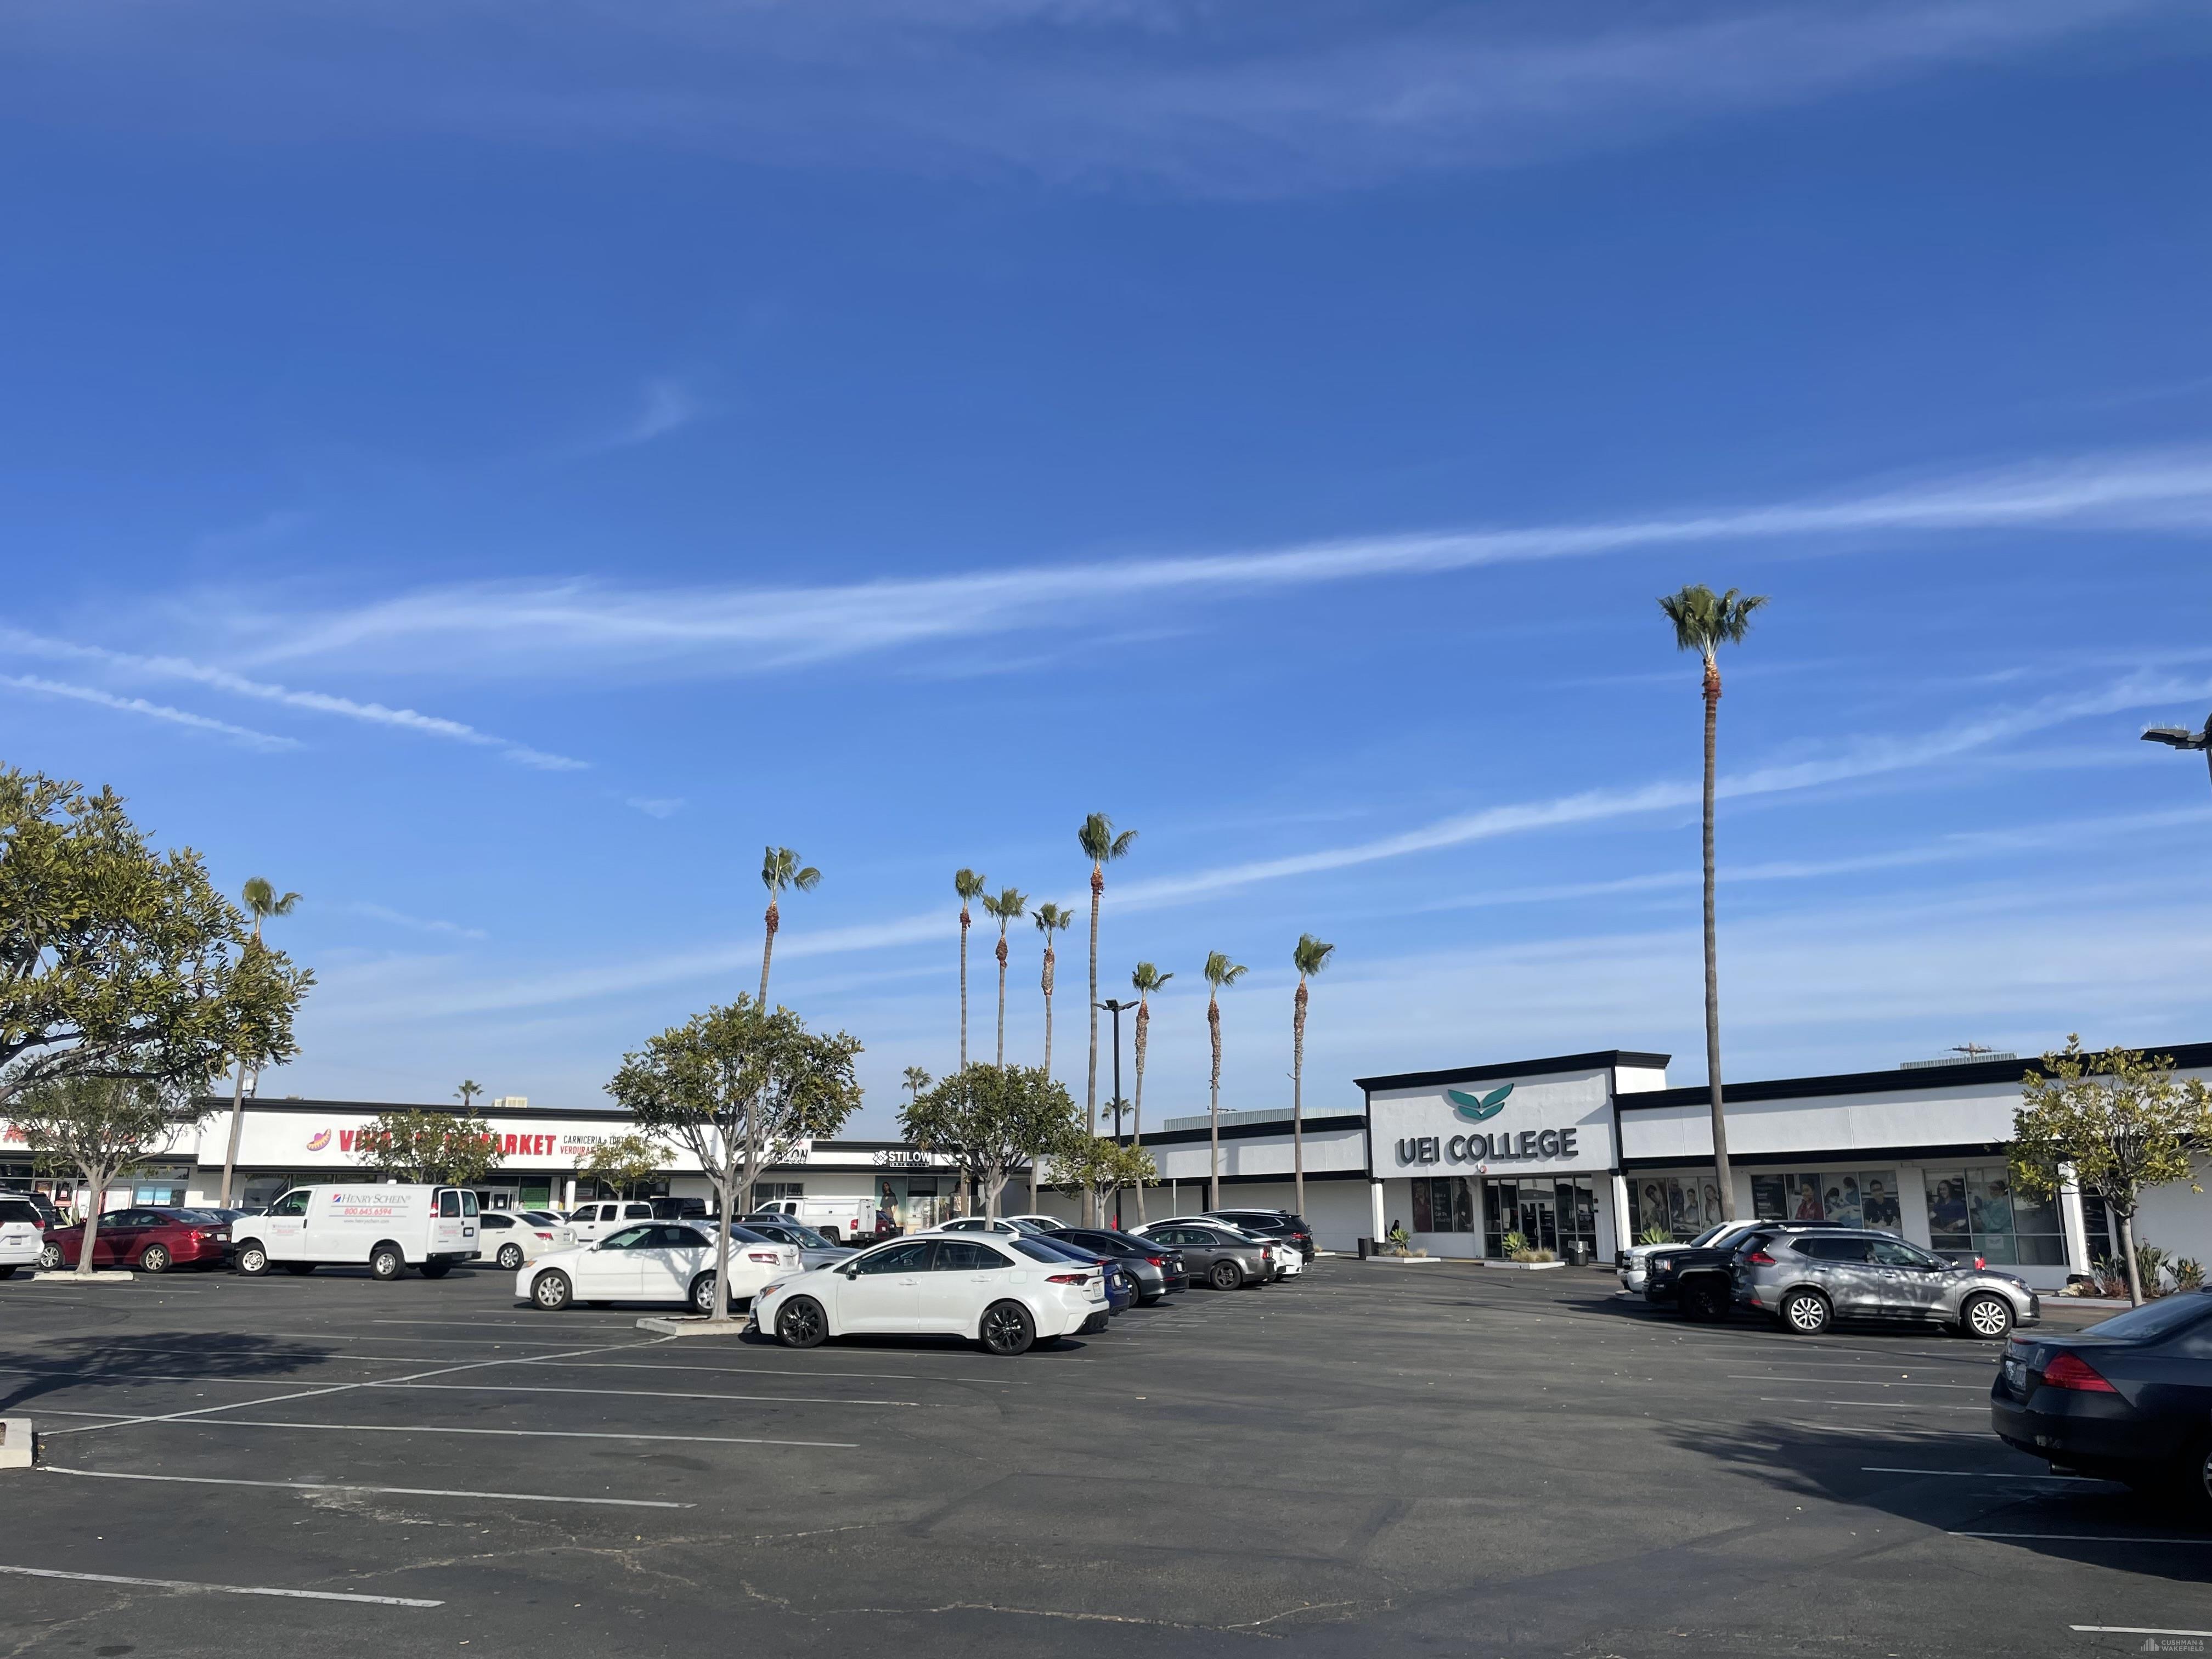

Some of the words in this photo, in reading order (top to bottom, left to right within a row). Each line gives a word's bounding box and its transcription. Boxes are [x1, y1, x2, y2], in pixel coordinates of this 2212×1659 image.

[563, 1135, 602, 1144] CARNICERIA
[1400, 1137, 1440, 1164] UEI
[1449, 1128, 1579, 1162] COLLEGE
[889, 1152, 932, 1162] STILOW
[342, 1194, 373, 1203] HENRY
